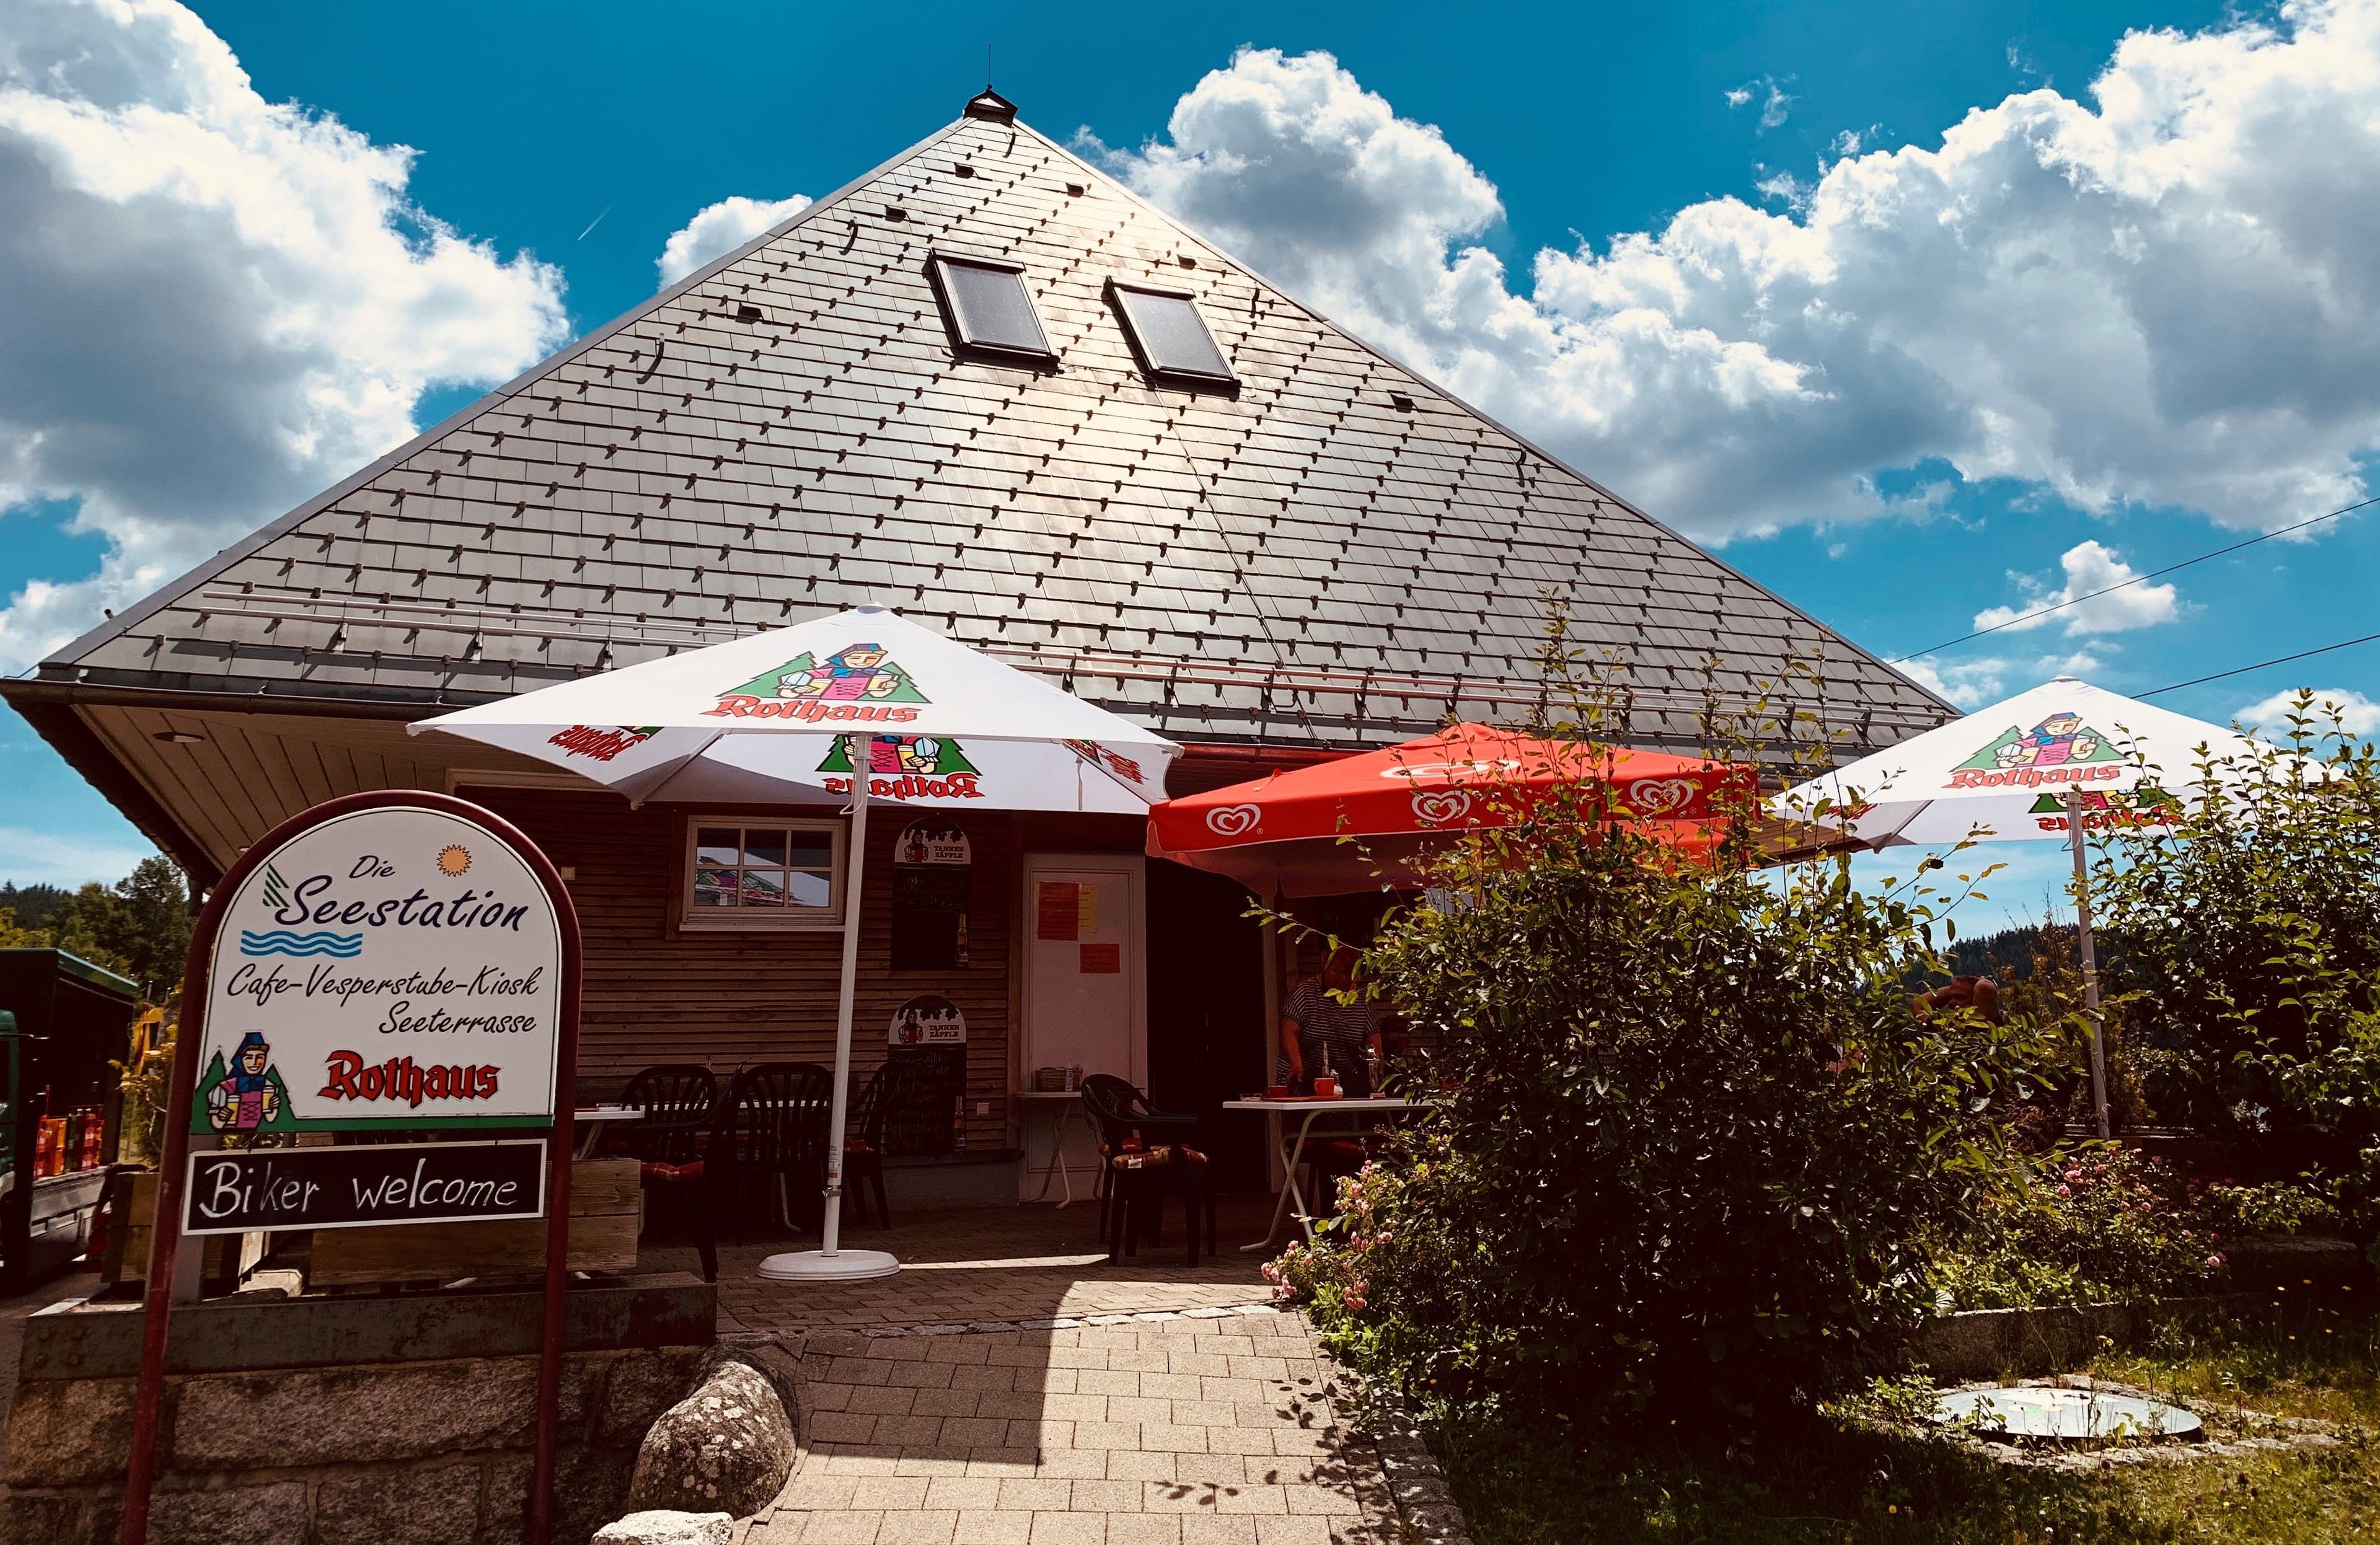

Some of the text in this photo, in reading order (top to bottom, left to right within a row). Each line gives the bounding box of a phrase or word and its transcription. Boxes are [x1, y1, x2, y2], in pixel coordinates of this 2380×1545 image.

[699, 695, 923, 723] Rothaus
[1941, 765, 2123, 788] Rothaus
[348, 855, 396, 879] Die
[275, 874, 529, 931] Seestation
[227, 963, 544, 1006] Cafe-Vesperstube-Kiosk
[379, 1000, 537, 1034] Seeterrasse
[317, 1049, 501, 1108] Rothaus
[199, 1158, 518, 1218] Biker welcome
